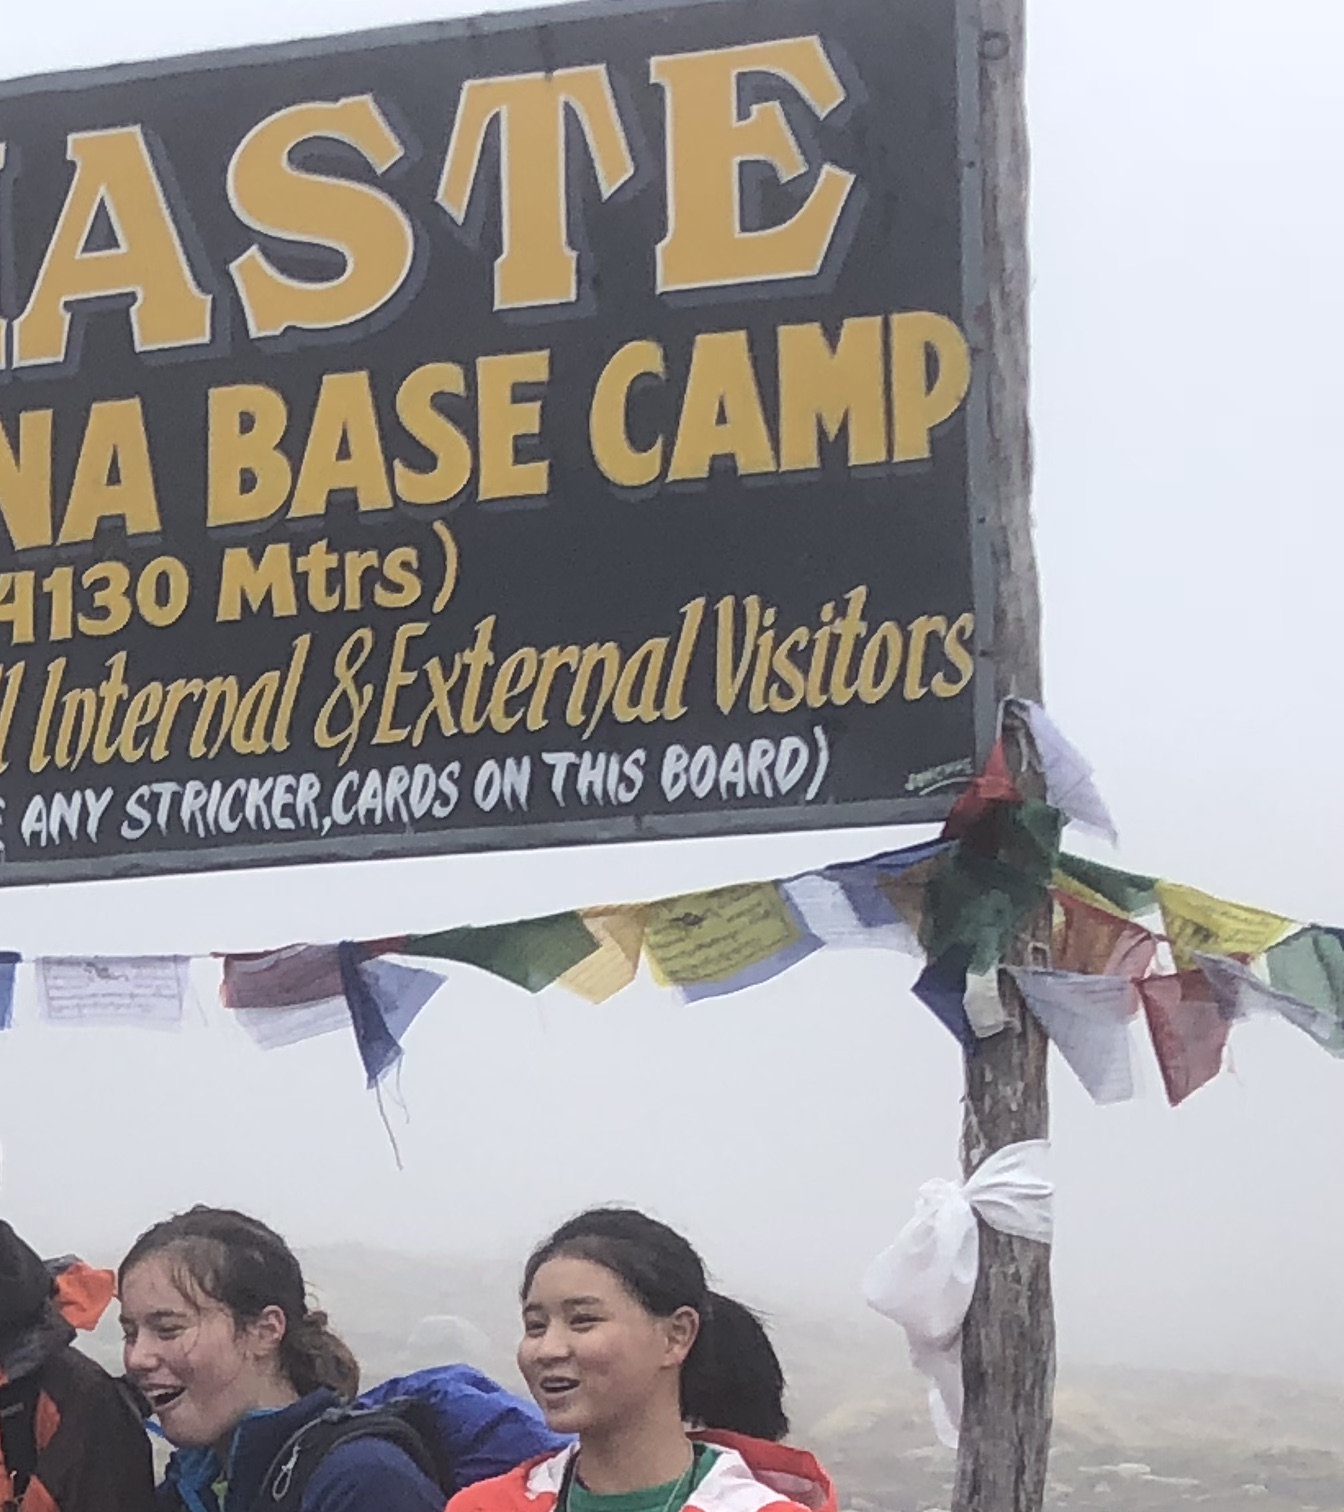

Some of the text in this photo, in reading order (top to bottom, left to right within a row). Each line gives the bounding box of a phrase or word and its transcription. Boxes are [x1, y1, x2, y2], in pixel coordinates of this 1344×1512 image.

[207, 350, 551, 528] BASE
[589, 310, 971, 487] CAMP
[216, 520, 458, 622] Mtrs)
[29, 633, 312, 773] Internal
[715, 585, 974, 715] Visitors
[21, 786, 113, 847] ANY
[474, 756, 532, 812] ON
[541, 748, 645, 807] THIS
[661, 725, 829, 801] BOARD)
